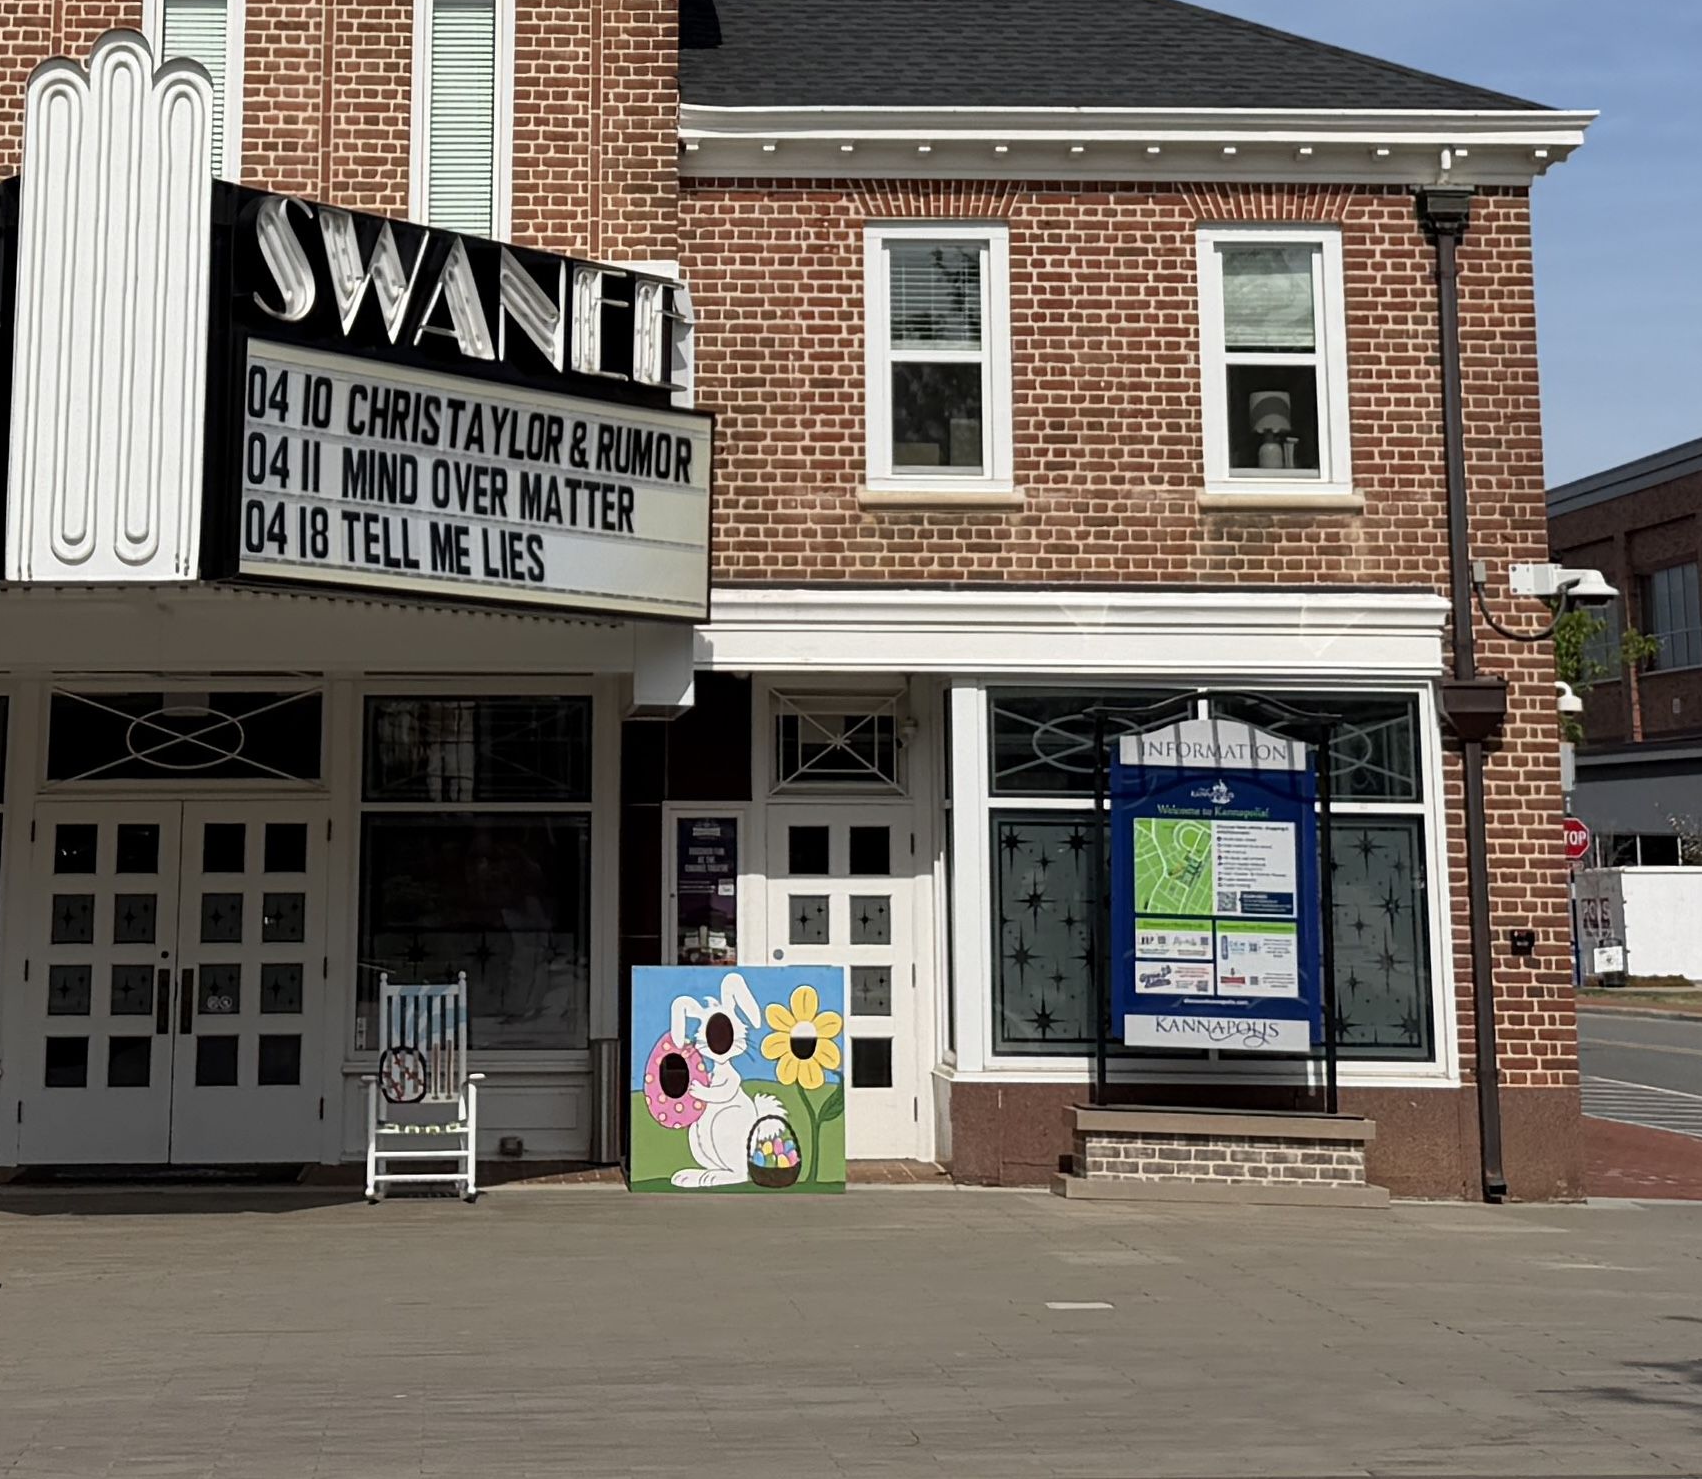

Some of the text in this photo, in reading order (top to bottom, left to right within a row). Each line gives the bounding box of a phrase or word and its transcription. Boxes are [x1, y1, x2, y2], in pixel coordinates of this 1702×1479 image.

[253, 194, 688, 392] SWANEE
[247, 365, 692, 484] 04 10 CHRIS TAYLOR & RUMOR
[247, 431, 634, 533] 04 11 MIND OVER MATTER
[245, 498, 545, 583] 04 18 TELL ME LIES
[1141, 740, 1287, 761] INFORMATION
[1563, 830, 1586, 846] TOP
[1155, 1016, 1279, 1048] KANNAPOLIS
